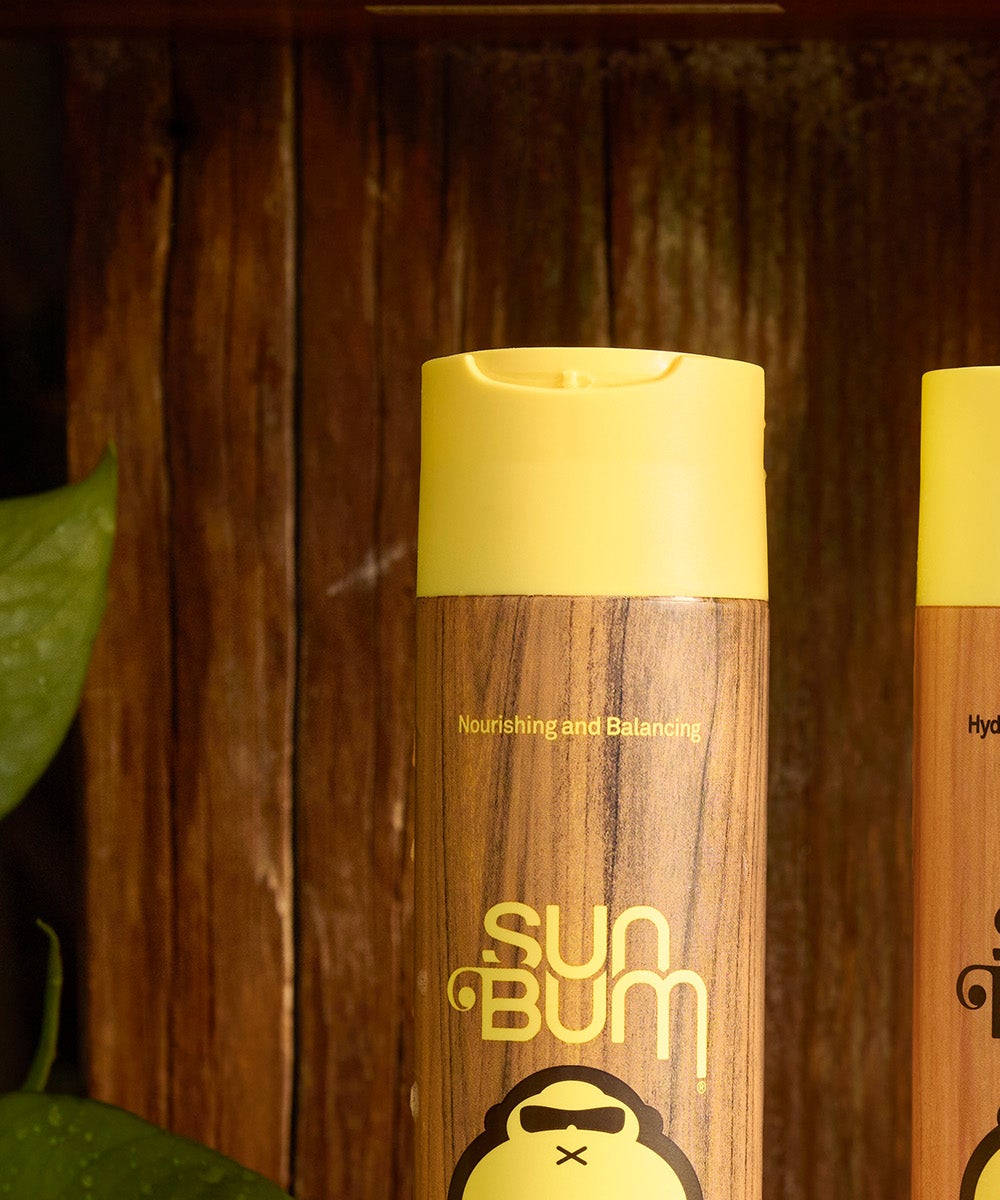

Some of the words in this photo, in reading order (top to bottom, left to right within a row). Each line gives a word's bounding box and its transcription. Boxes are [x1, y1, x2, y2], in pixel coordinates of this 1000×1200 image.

[458, 715, 557, 740] Nourishing
[561, 717, 601, 735] and
[606, 717, 701, 742] Balancing
